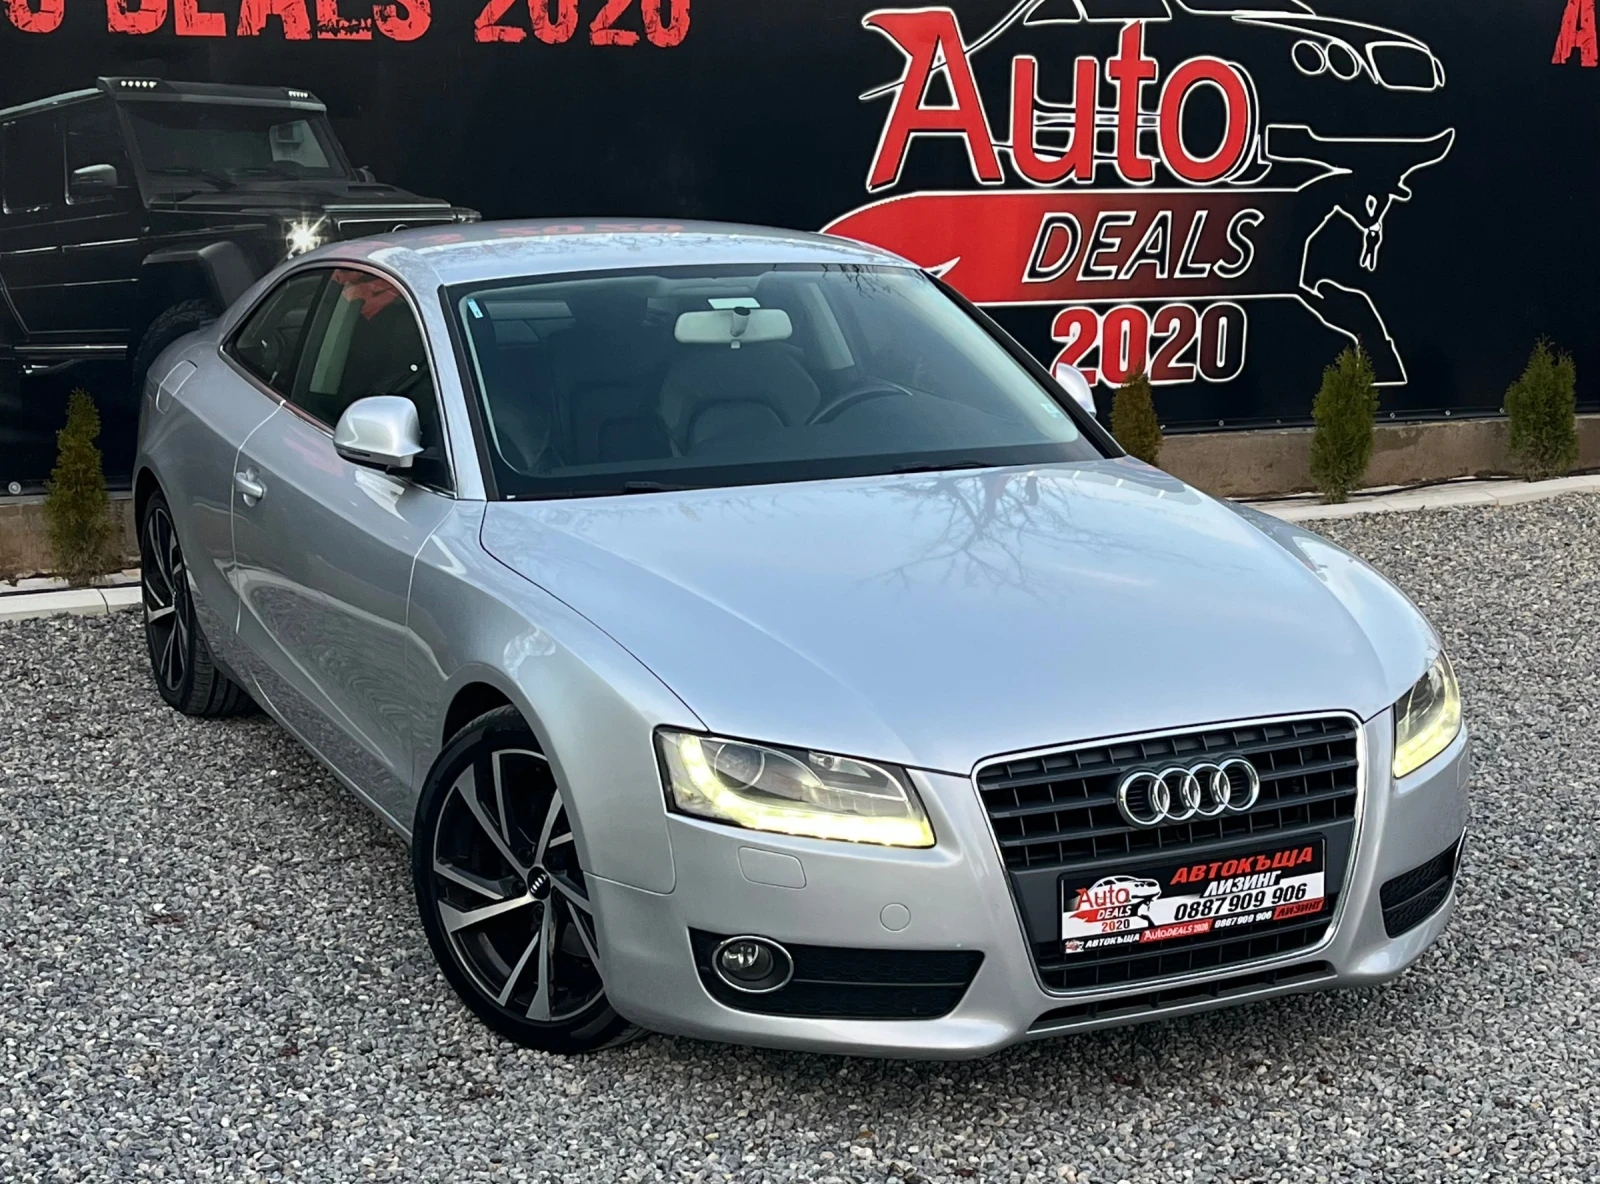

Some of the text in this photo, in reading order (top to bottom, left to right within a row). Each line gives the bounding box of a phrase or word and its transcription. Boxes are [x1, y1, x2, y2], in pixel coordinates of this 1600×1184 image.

[862, 8, 1252, 190] Auto
[1022, 208, 1264, 284] DEALS
[1050, 302, 1247, 388] 2020
[1169, 846, 1313, 886] АВТОКЪЩА
[1075, 884, 1131, 911] Auto
[1202, 870, 1282, 898] ЛИЗИНГ
[1097, 905, 1132, 920] DEALS
[1174, 882, 1307, 921] 0887 909 906
[1276, 900, 1324, 918] ЛИЗИНГ
[1101, 918, 1131, 933] 2020
[1085, 933, 1140, 948] АВТОКЪЩА
